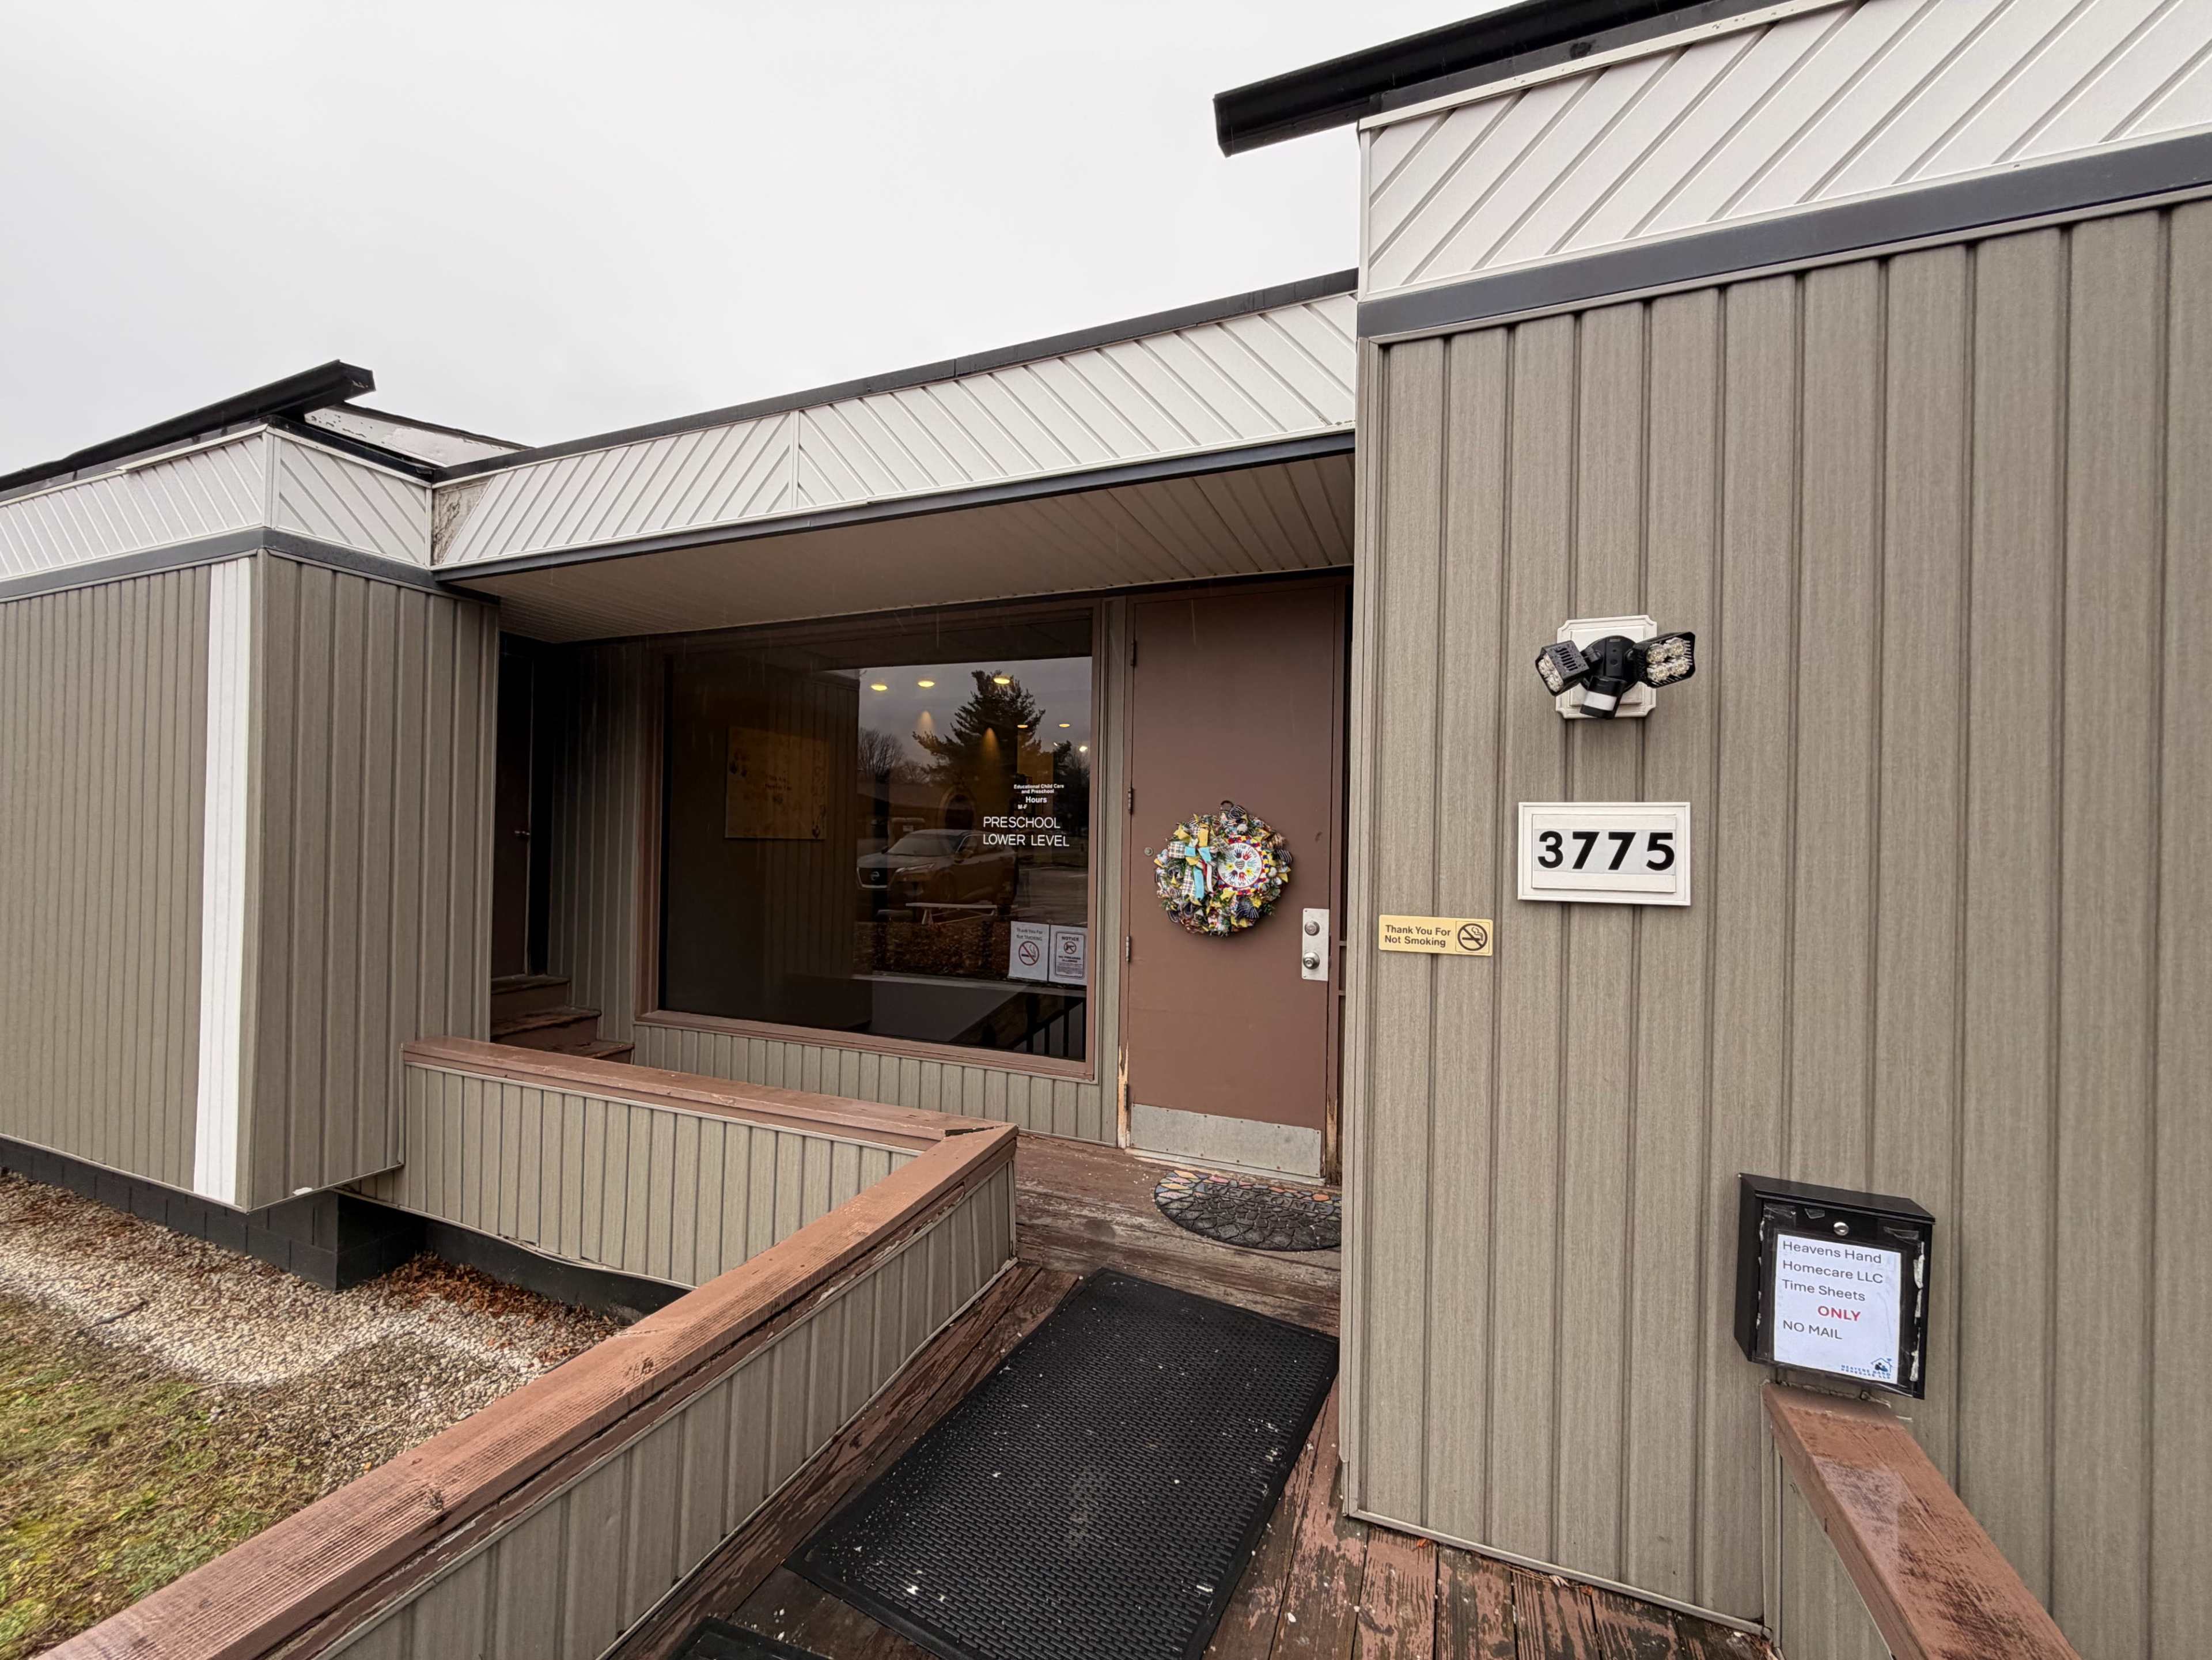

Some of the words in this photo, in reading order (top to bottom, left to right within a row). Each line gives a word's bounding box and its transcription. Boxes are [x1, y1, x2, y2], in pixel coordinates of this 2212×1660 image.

[983, 816, 1061, 829] PRESCHOOL
[983, 834, 1025, 846] LOWER
[1031, 835, 1070, 846] LEVEL
[1537, 830, 1675, 871] 3775
[1385, 925, 1414, 934] Thank
[1415, 926, 1433, 935] You
[1435, 928, 1452, 936] For
[1385, 935, 1401, 944] Not
[1404, 936, 1446, 948] Smoking
[1207, 1183, 1331, 1214] WELCOME
[1783, 1240, 1840, 1258] Heavens
[1844, 1249, 1881, 1264] Hand
[1783, 1260, 1853, 1279] Homecare
[1857, 1270, 1884, 1284] LLC
[1782, 1279, 1815, 1294] Time
[1819, 1285, 1866, 1302] Sheets
[1817, 1306, 1861, 1321] ONLY
[1783, 1319, 1805, 1332] NO
[1809, 1325, 1843, 1340] MAIL
